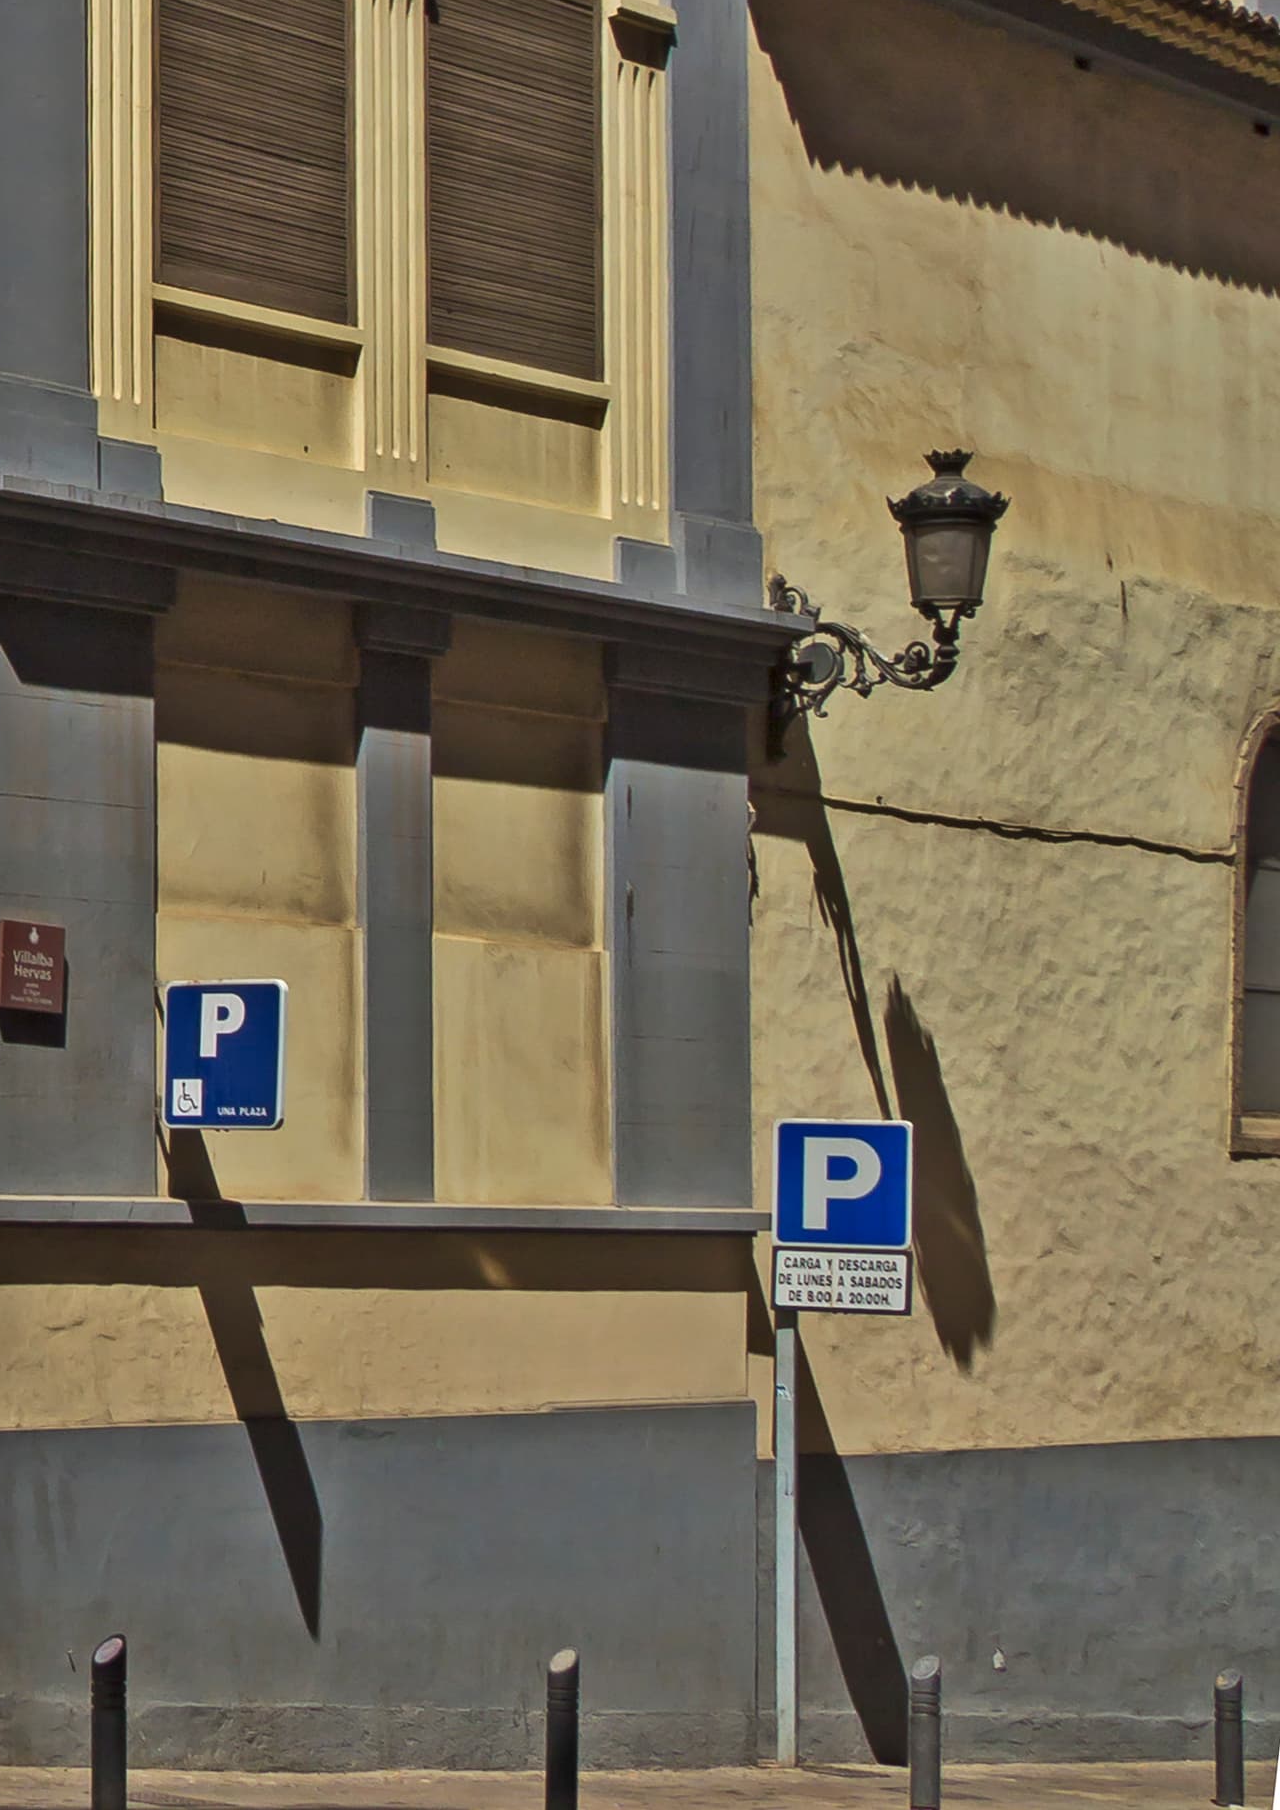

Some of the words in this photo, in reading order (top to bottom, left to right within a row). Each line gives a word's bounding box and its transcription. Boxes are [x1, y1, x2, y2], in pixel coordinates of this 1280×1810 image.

[13, 949, 54, 967] Villalba
[200, 993, 245, 1057] P
[217, 1107, 236, 1117] UNA
[239, 1107, 268, 1117] PLAZA
[803, 1137, 881, 1230] P
[783, 1257, 821, 1269] CARGA
[827, 1259, 833, 1270] Y
[838, 1259, 898, 1272] DESCARGA
[778, 1273, 792, 1285] DE
[797, 1274, 833, 1287] LUNES
[837, 1276, 845, 1287] A
[850, 1276, 903, 1289] SABADOS
[788, 1290, 802, 1302] DE
[836, 1292, 843, 1303] A
